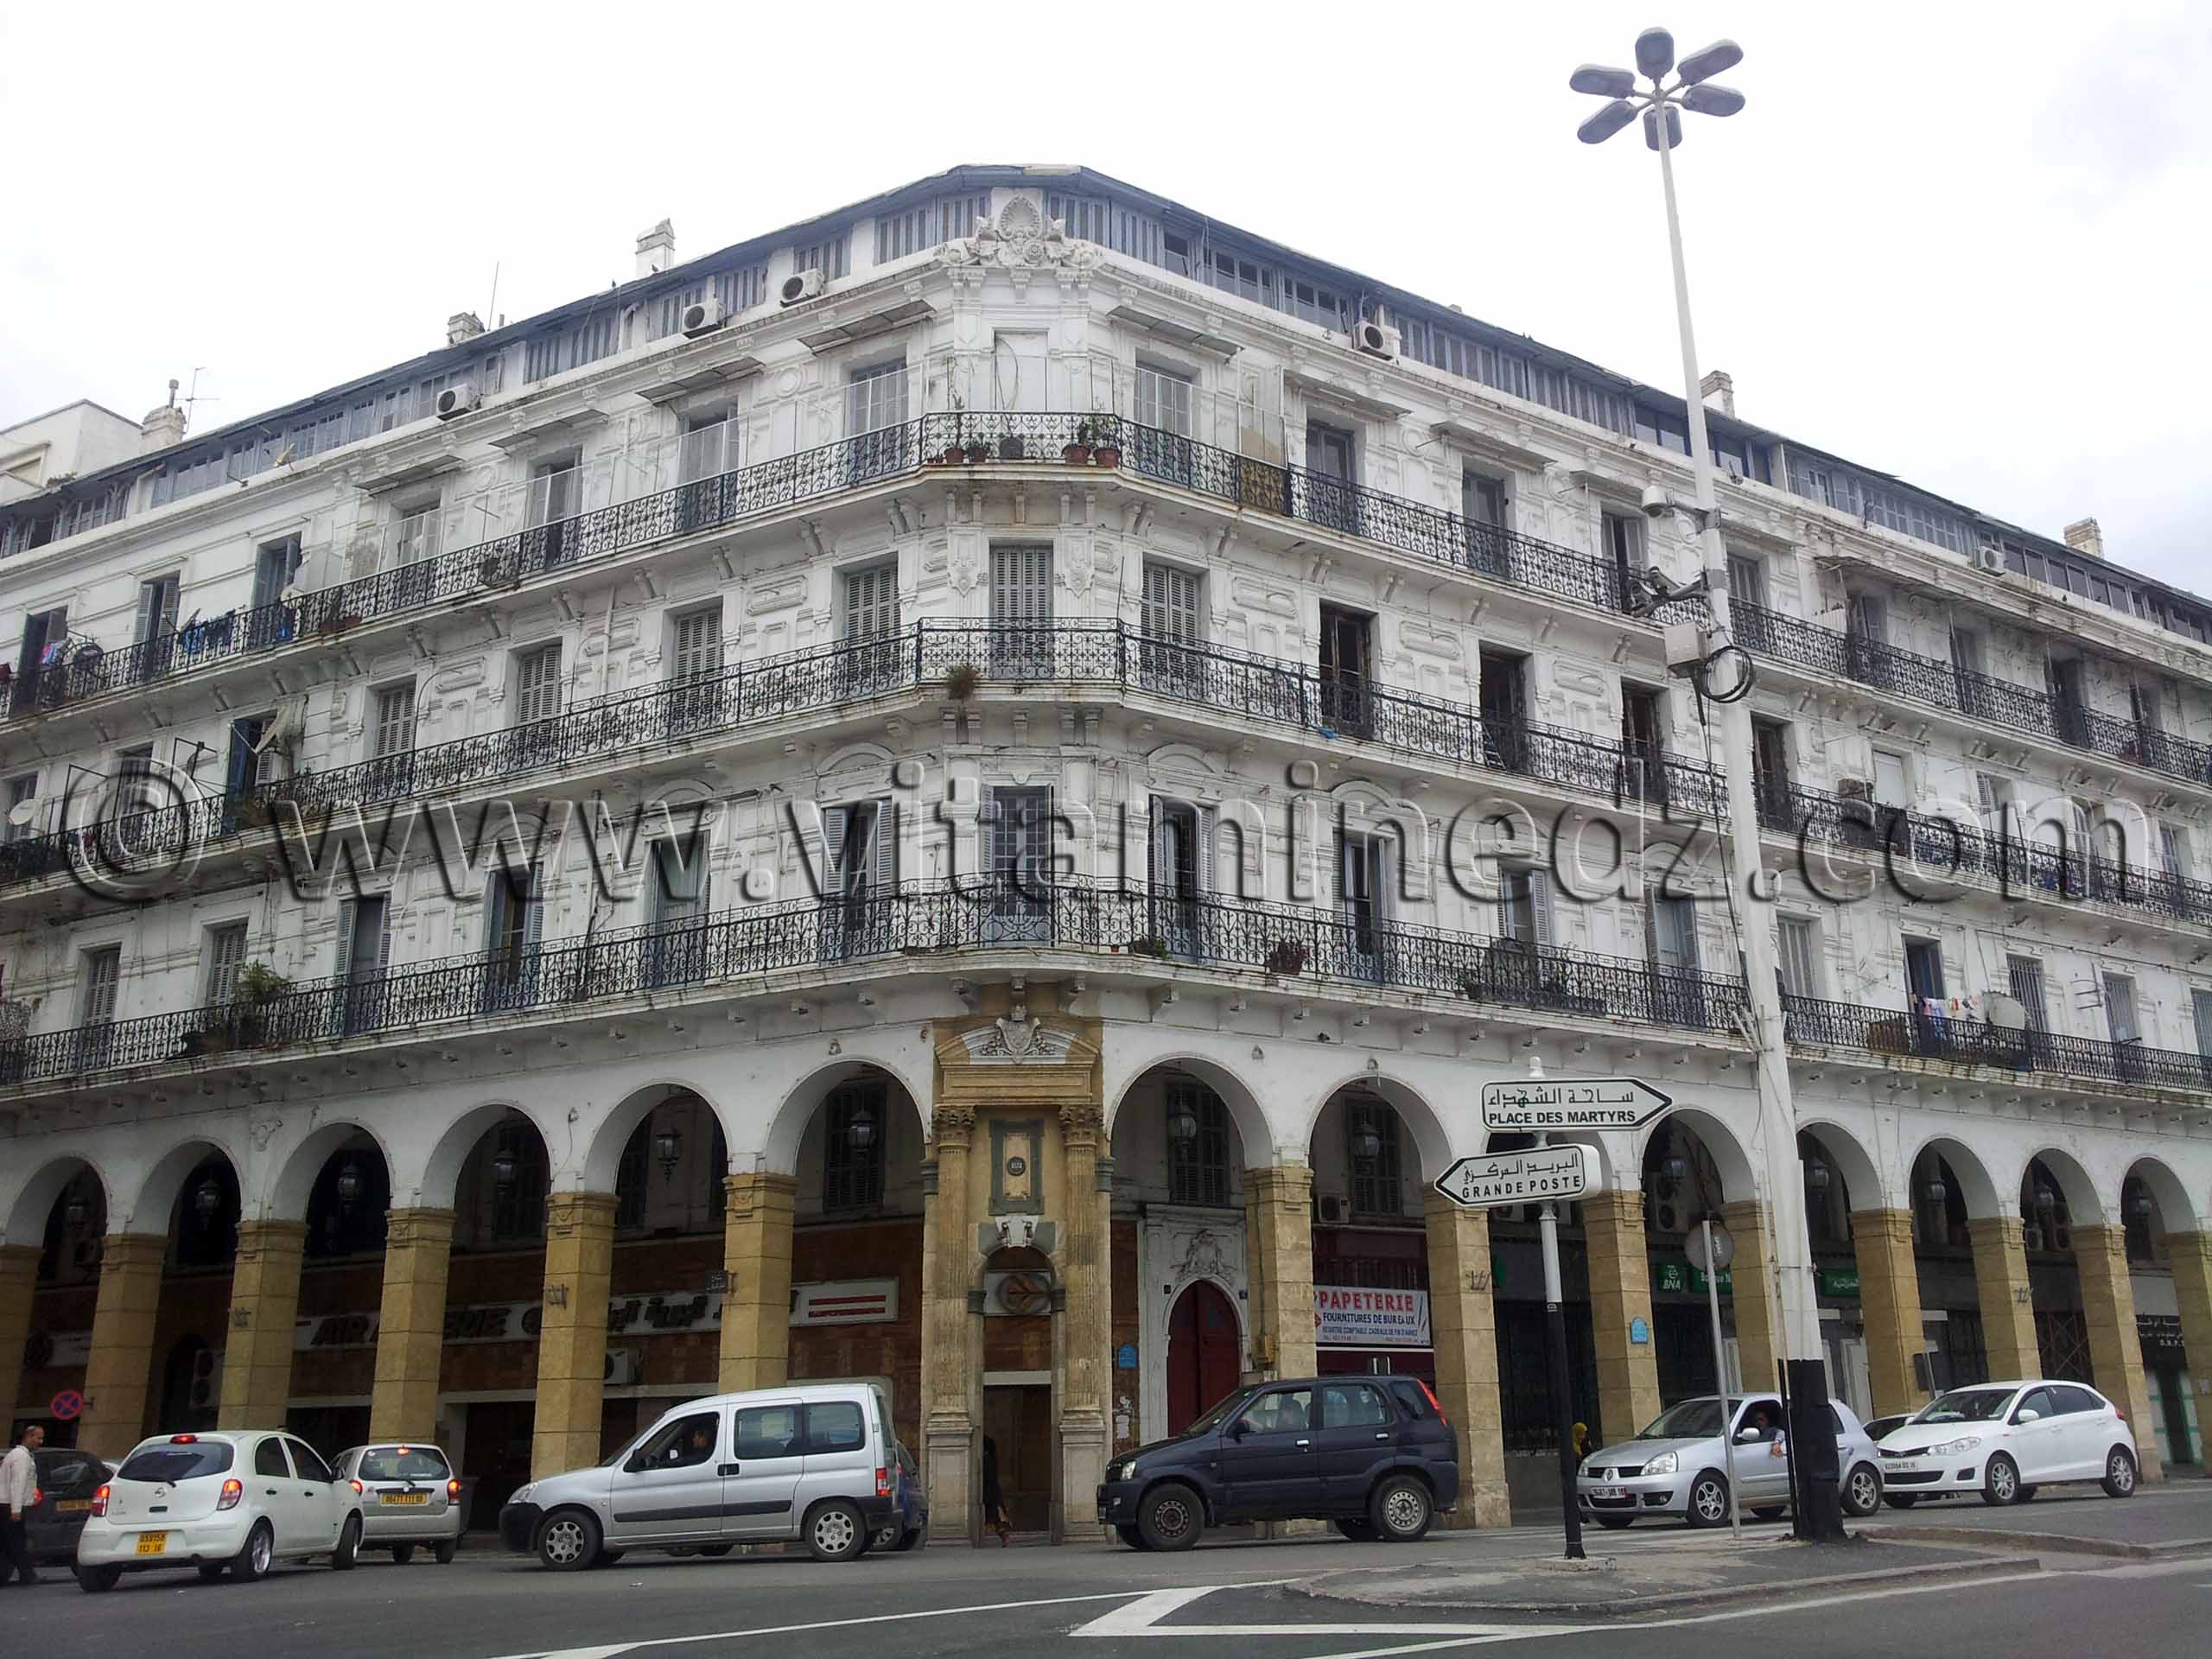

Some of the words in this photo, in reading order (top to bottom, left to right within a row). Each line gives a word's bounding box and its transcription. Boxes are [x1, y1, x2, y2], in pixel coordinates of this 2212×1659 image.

[1488, 1085, 1562, 1109] الشهداء
[1568, 1088, 1634, 1103] ساحة
[1489, 1112, 1533, 1124] PLACE
[1536, 1111, 1563, 1123] DES
[1567, 1110, 1637, 1122] MARTYRS
[1463, 1159, 1523, 1185] المركزي
[1526, 1153, 1579, 1176] البريد
[1462, 1181, 1523, 1198] GRANDE
[1529, 1175, 1581, 1192] POSTE
[1662, 1279, 1681, 1290] BNA
[1318, 1290, 1414, 1313] PAPETERIE
[311, 1314, 369, 1345] AIR
[1323, 1313, 1372, 1324] FOURNITURES
[1373, 1313, 1382, 1324] DE
[1383, 1314, 1415, 1325] BUREAUX
